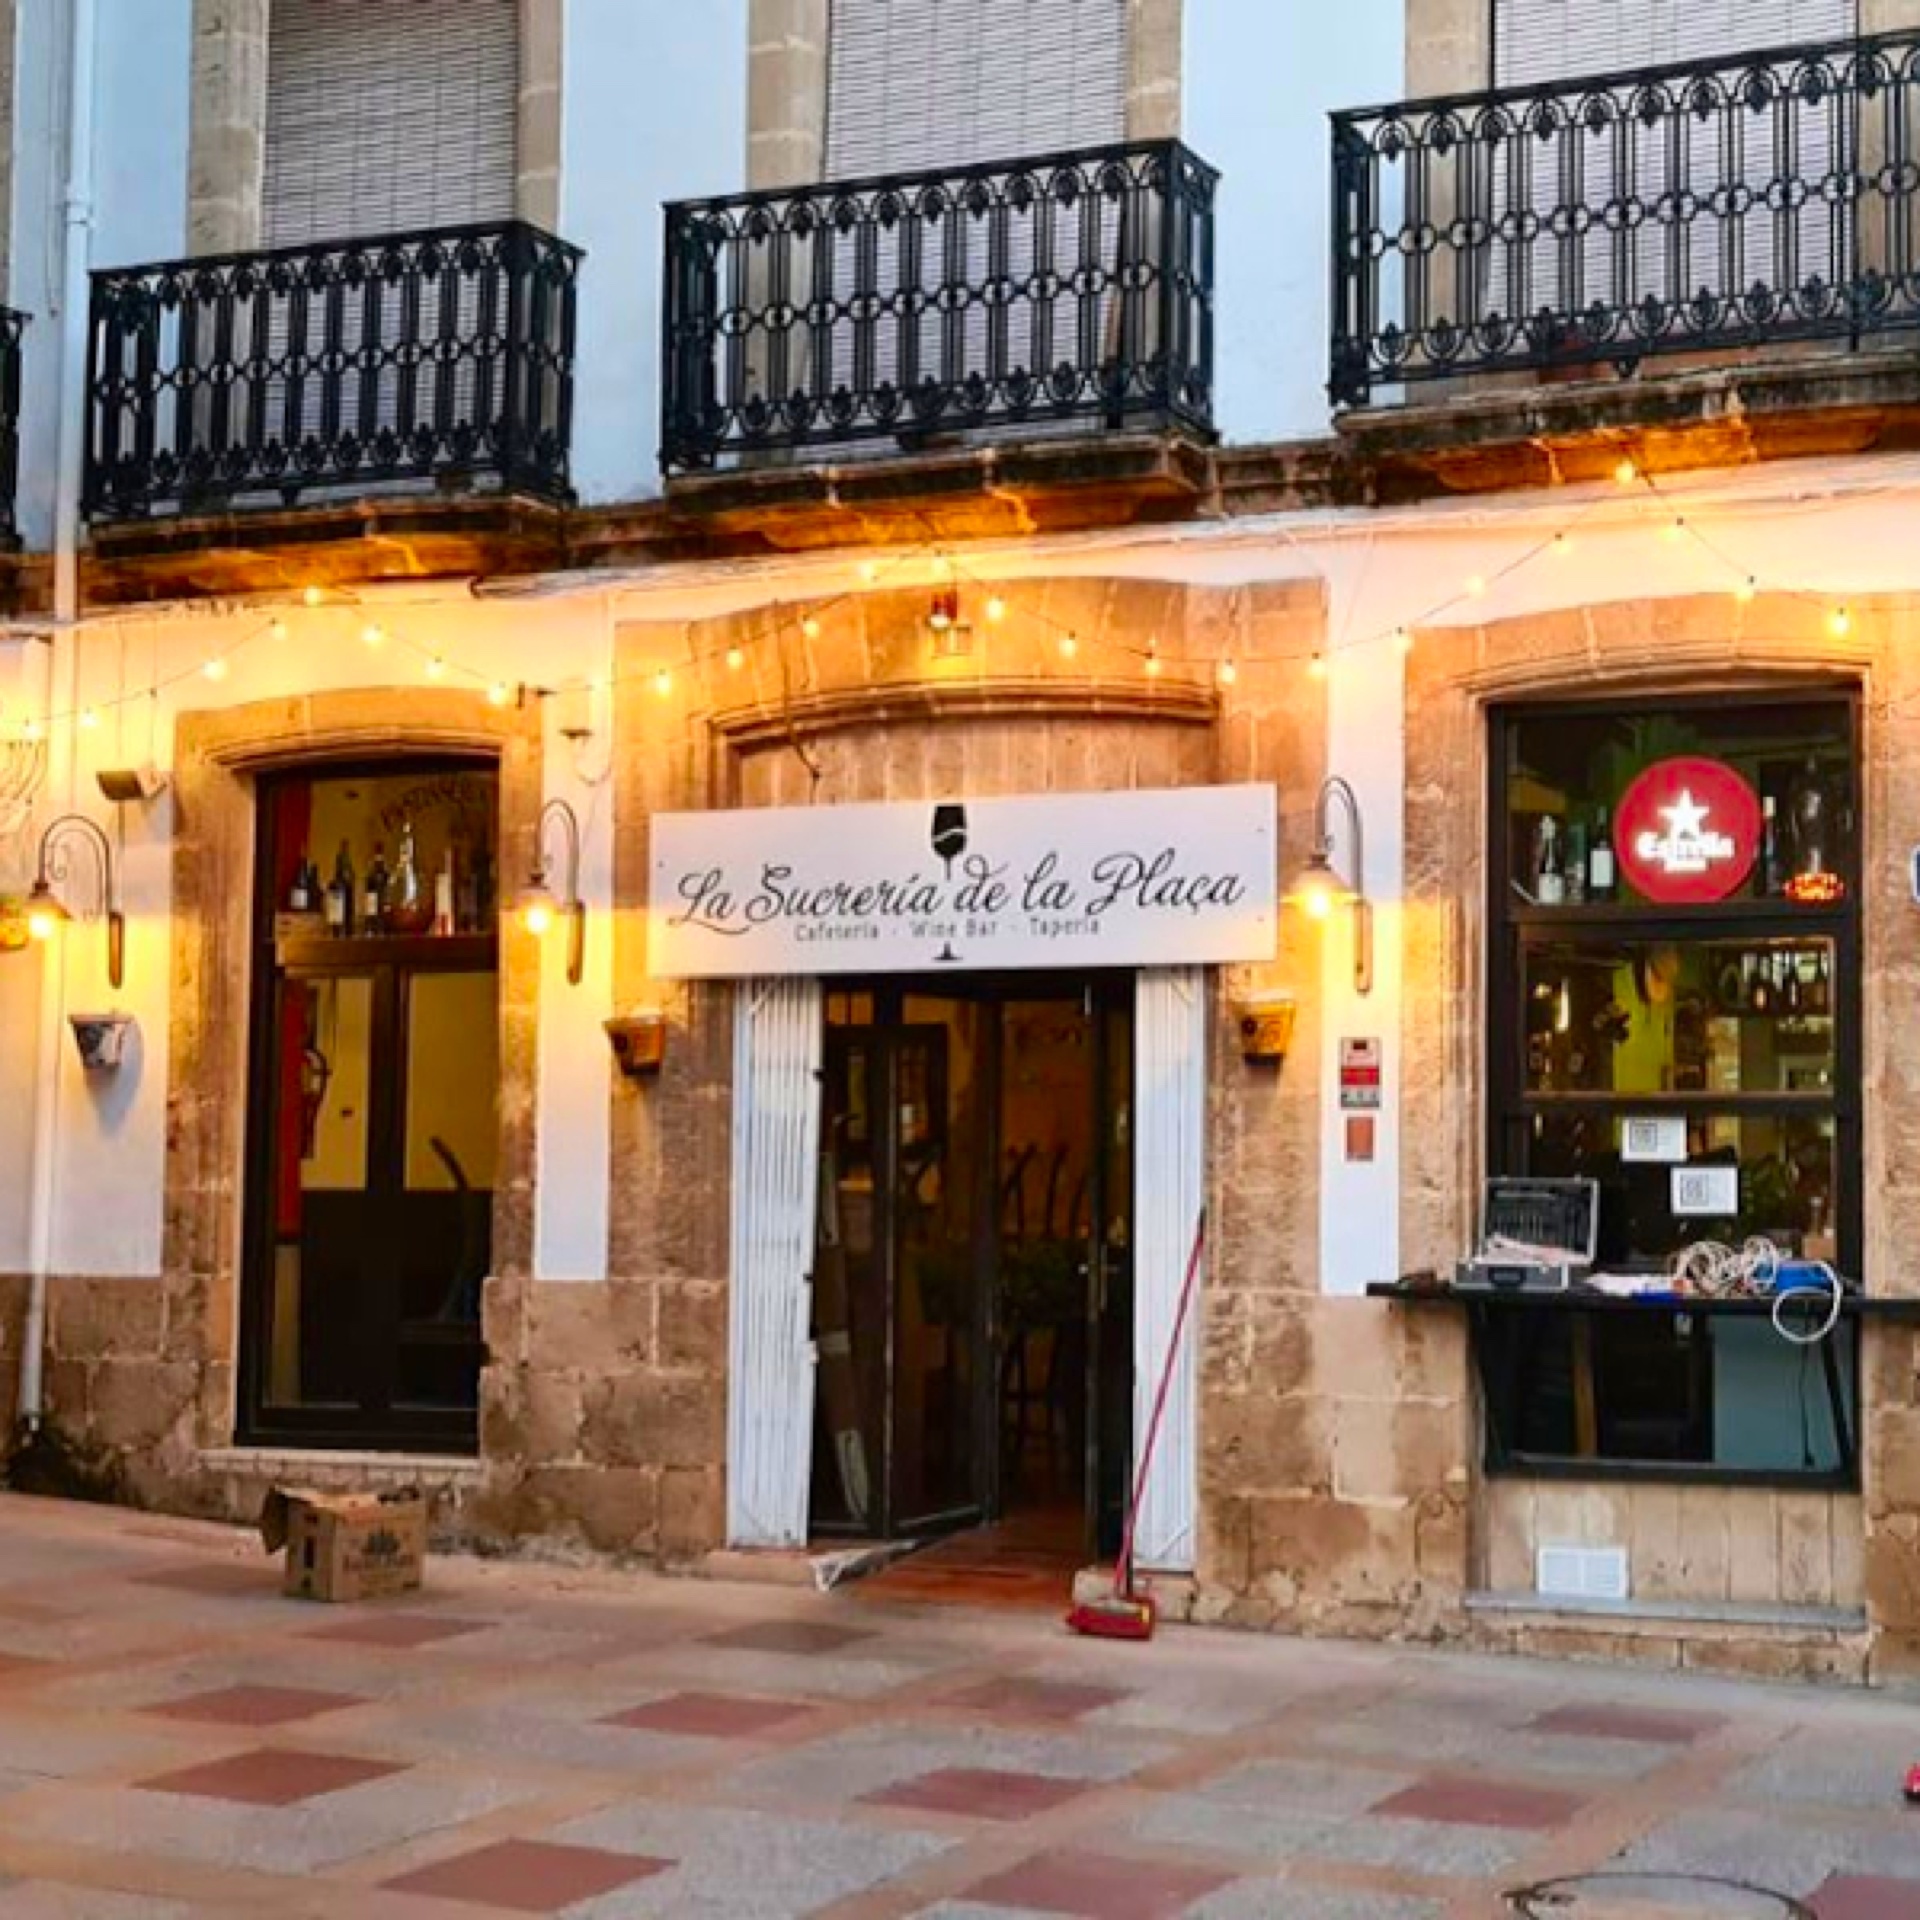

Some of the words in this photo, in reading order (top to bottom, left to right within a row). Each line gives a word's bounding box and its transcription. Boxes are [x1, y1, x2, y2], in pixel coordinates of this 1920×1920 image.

[667, 867, 750, 935] La
[744, 861, 943, 923] Sucrería
[952, 852, 1010, 914] de
[1021, 849, 1076, 913] la
[1083, 846, 1246, 917] Plaça
[966, 917, 998, 937] Bar
